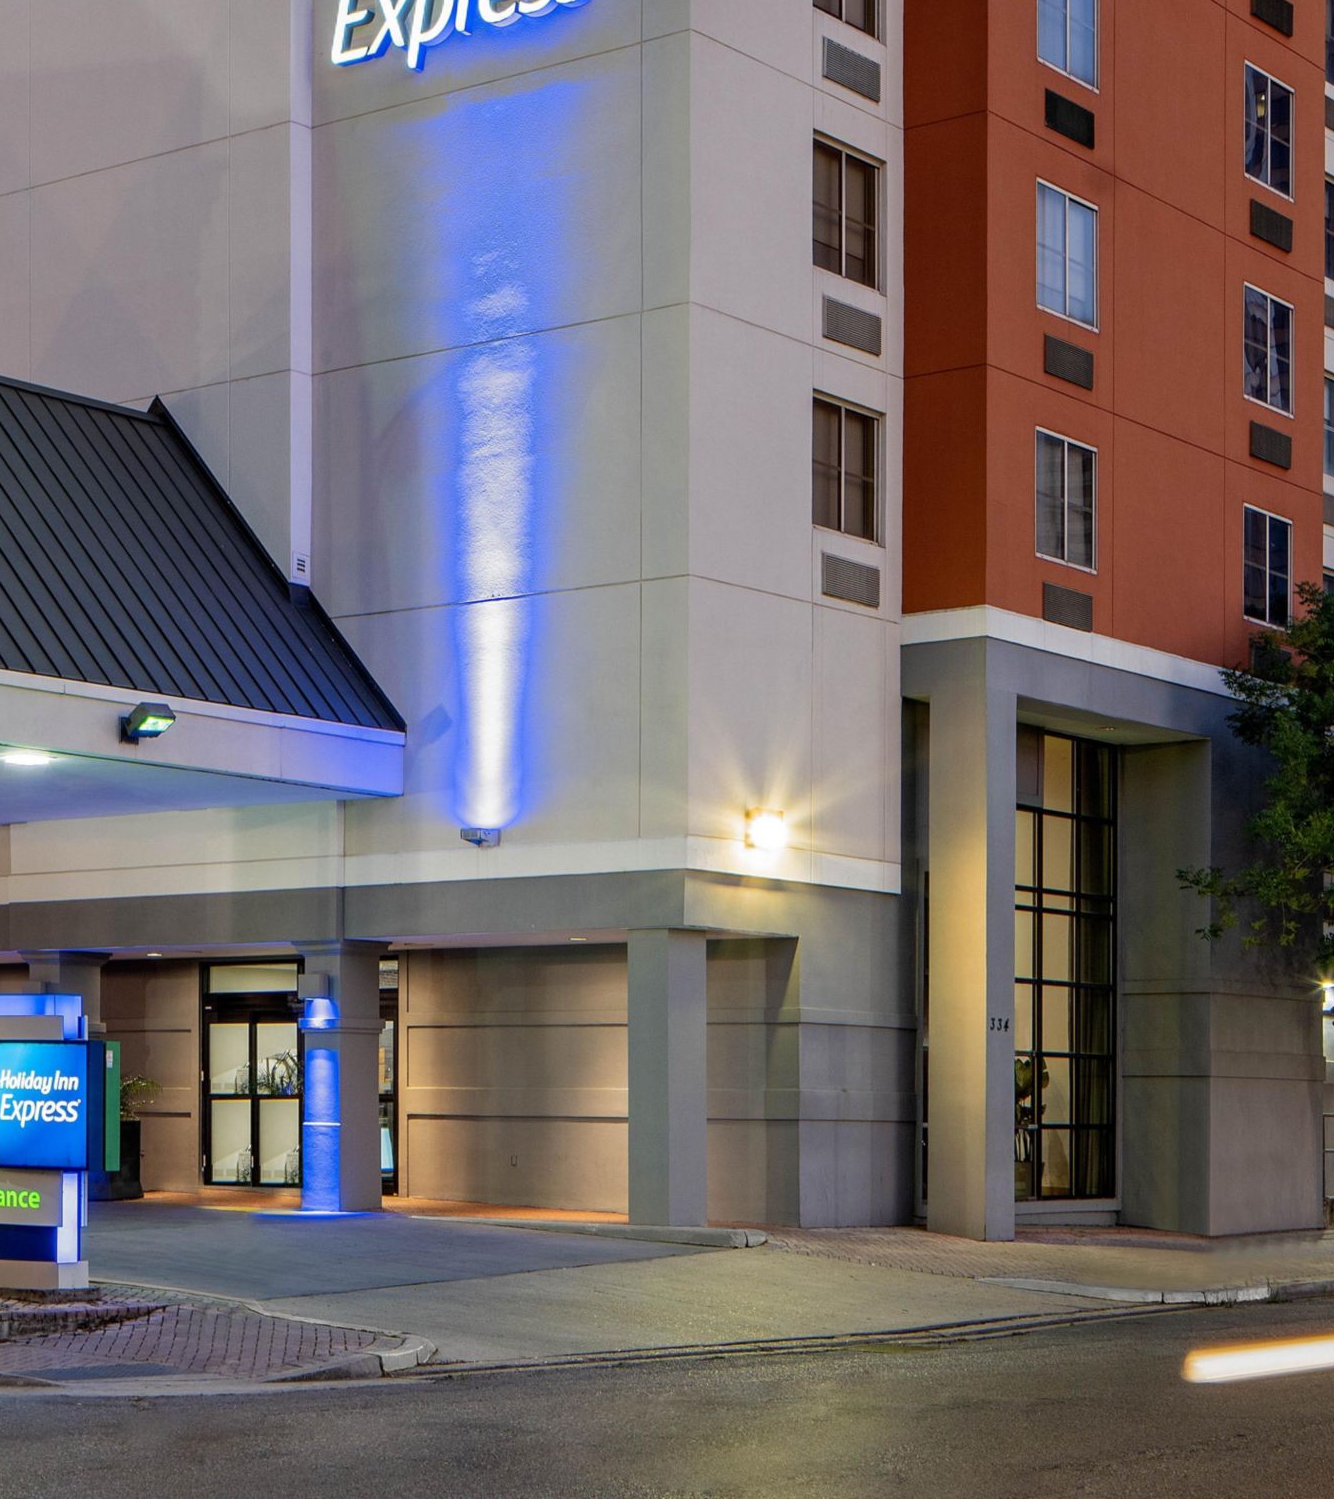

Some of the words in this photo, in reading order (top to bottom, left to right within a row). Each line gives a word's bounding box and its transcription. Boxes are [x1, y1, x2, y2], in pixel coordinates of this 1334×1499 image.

[990, 1017, 1010, 1033] 334
[0, 1069, 53, 1094] Holiday
[53, 1070, 79, 1091] Inn
[0, 1093, 80, 1129] Express
